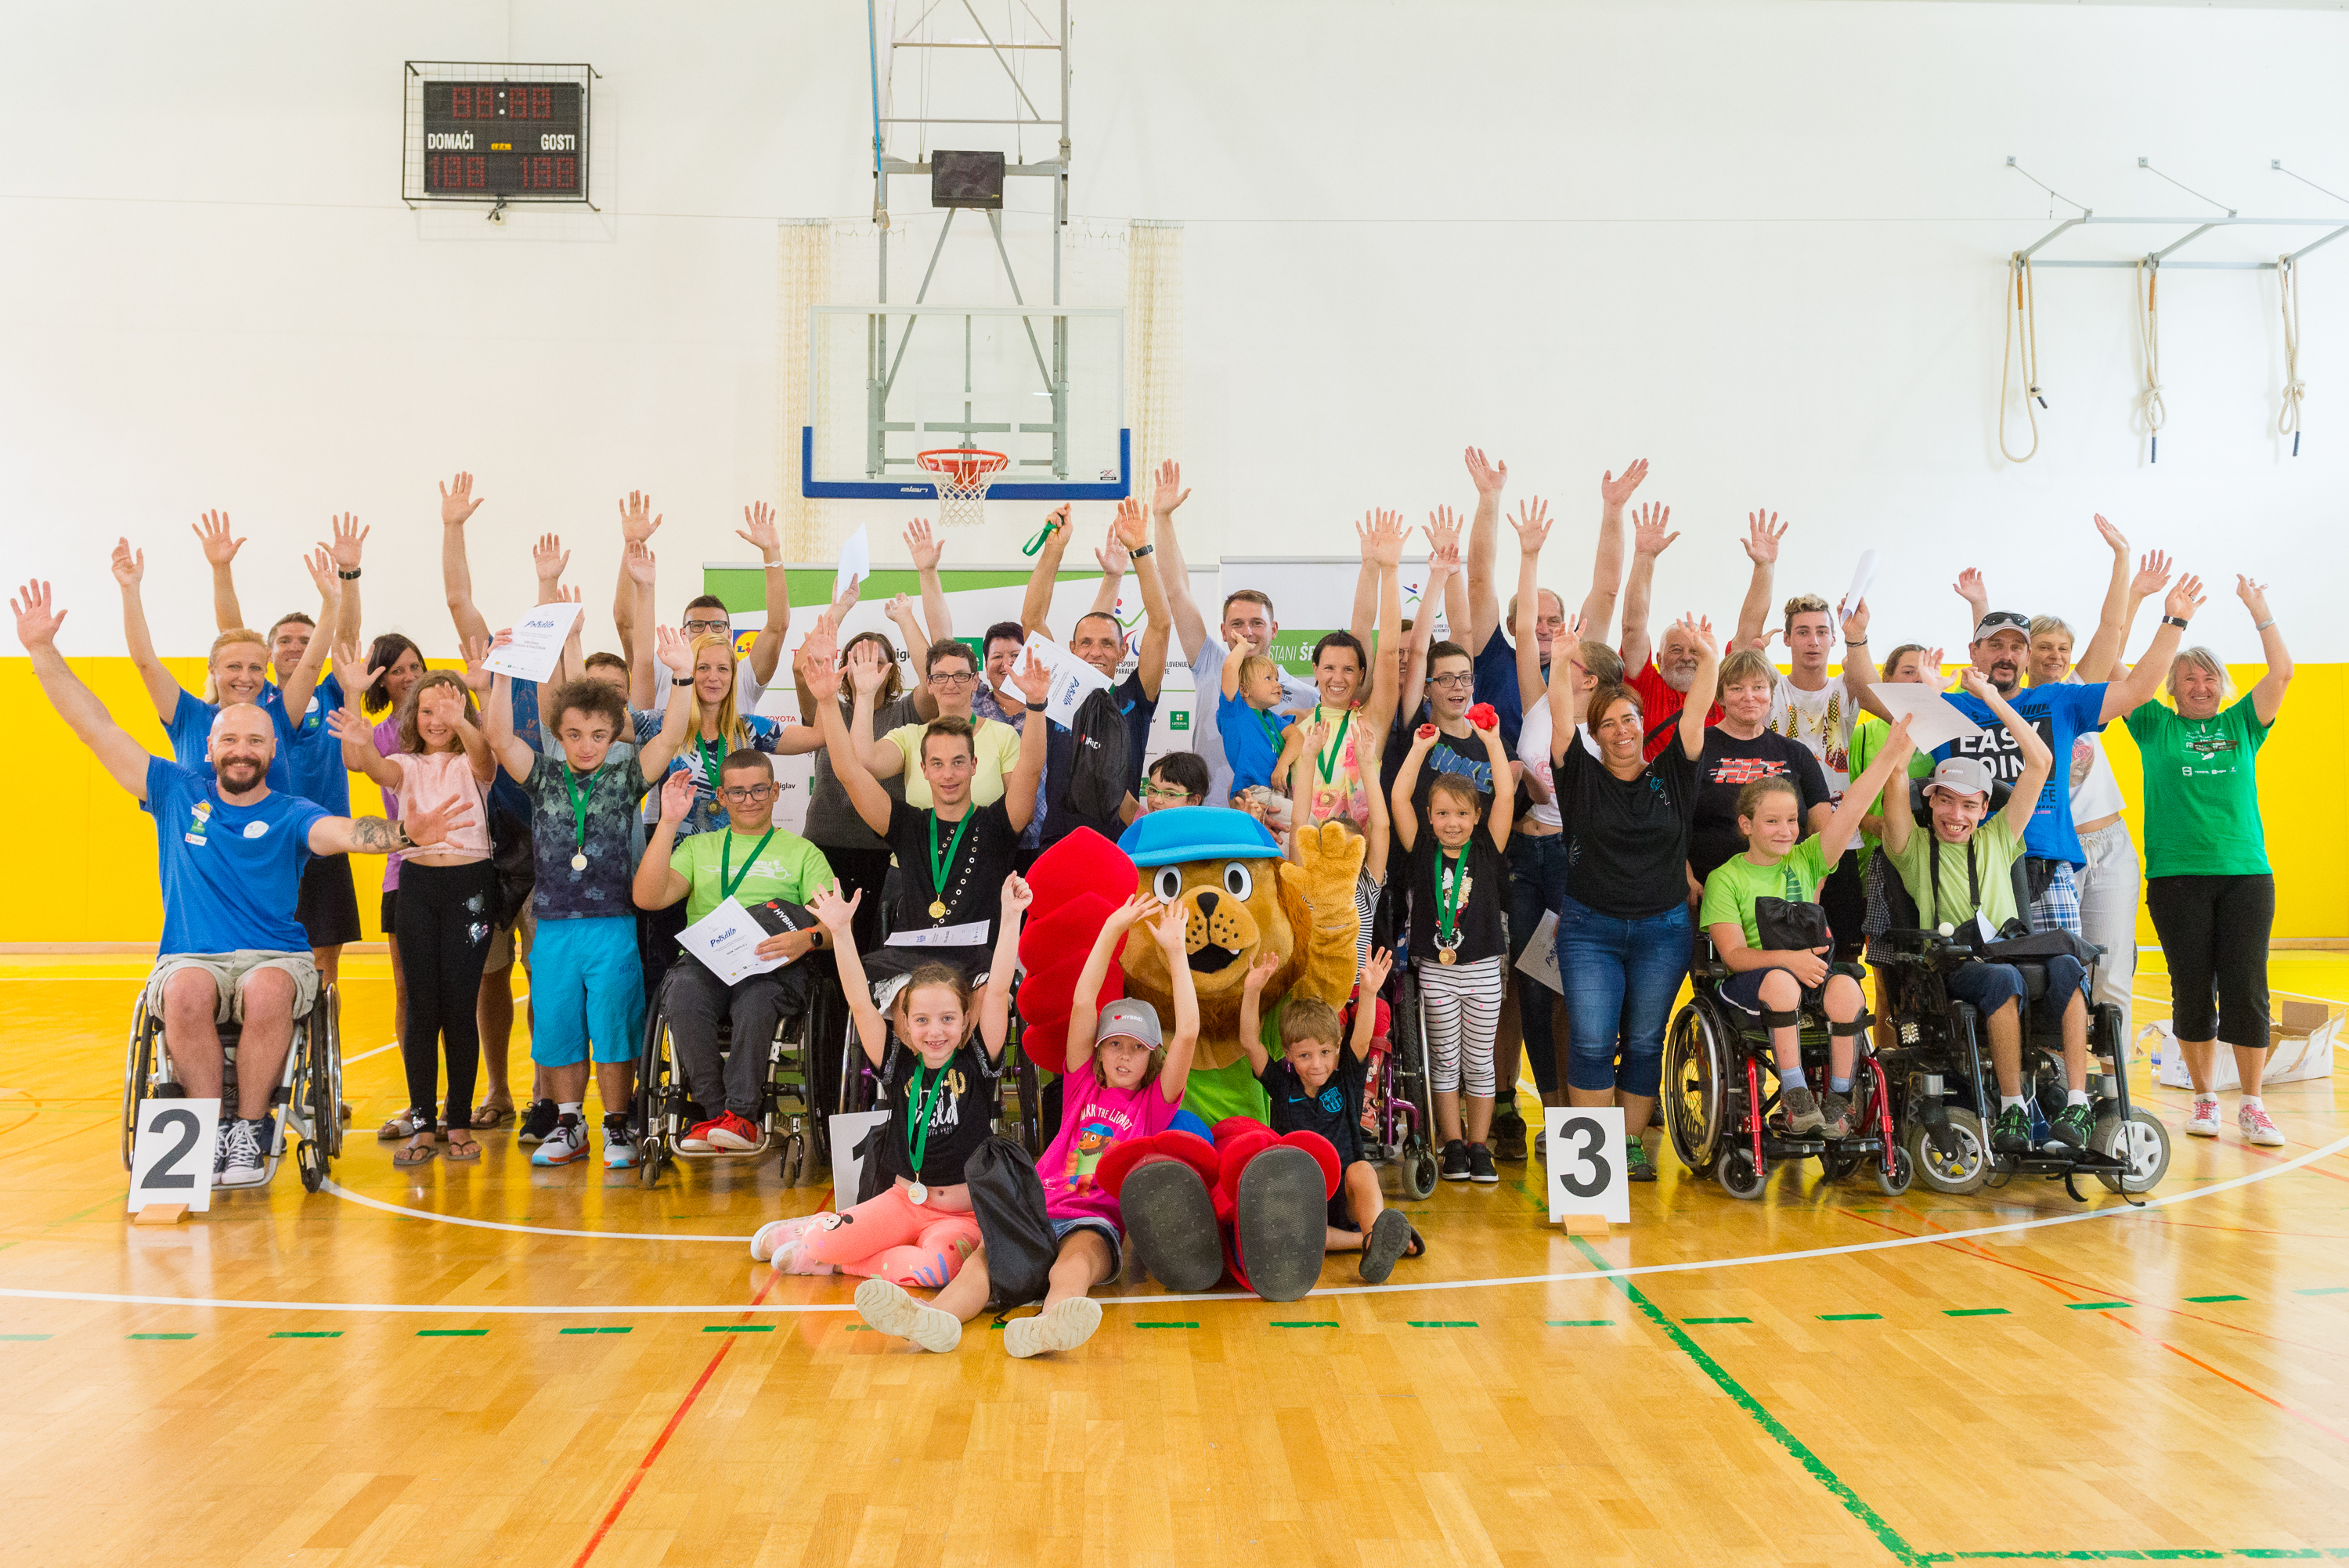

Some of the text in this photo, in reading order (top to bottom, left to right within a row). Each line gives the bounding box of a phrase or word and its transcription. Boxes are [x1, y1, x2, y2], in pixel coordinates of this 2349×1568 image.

[428, 130, 474, 150] DOMAĆI
[540, 134, 575, 150] GOSTI
[1098, 1107, 1110, 1119] THE
[140, 1108, 200, 1189] 2
[1559, 1116, 1611, 1198] 3
